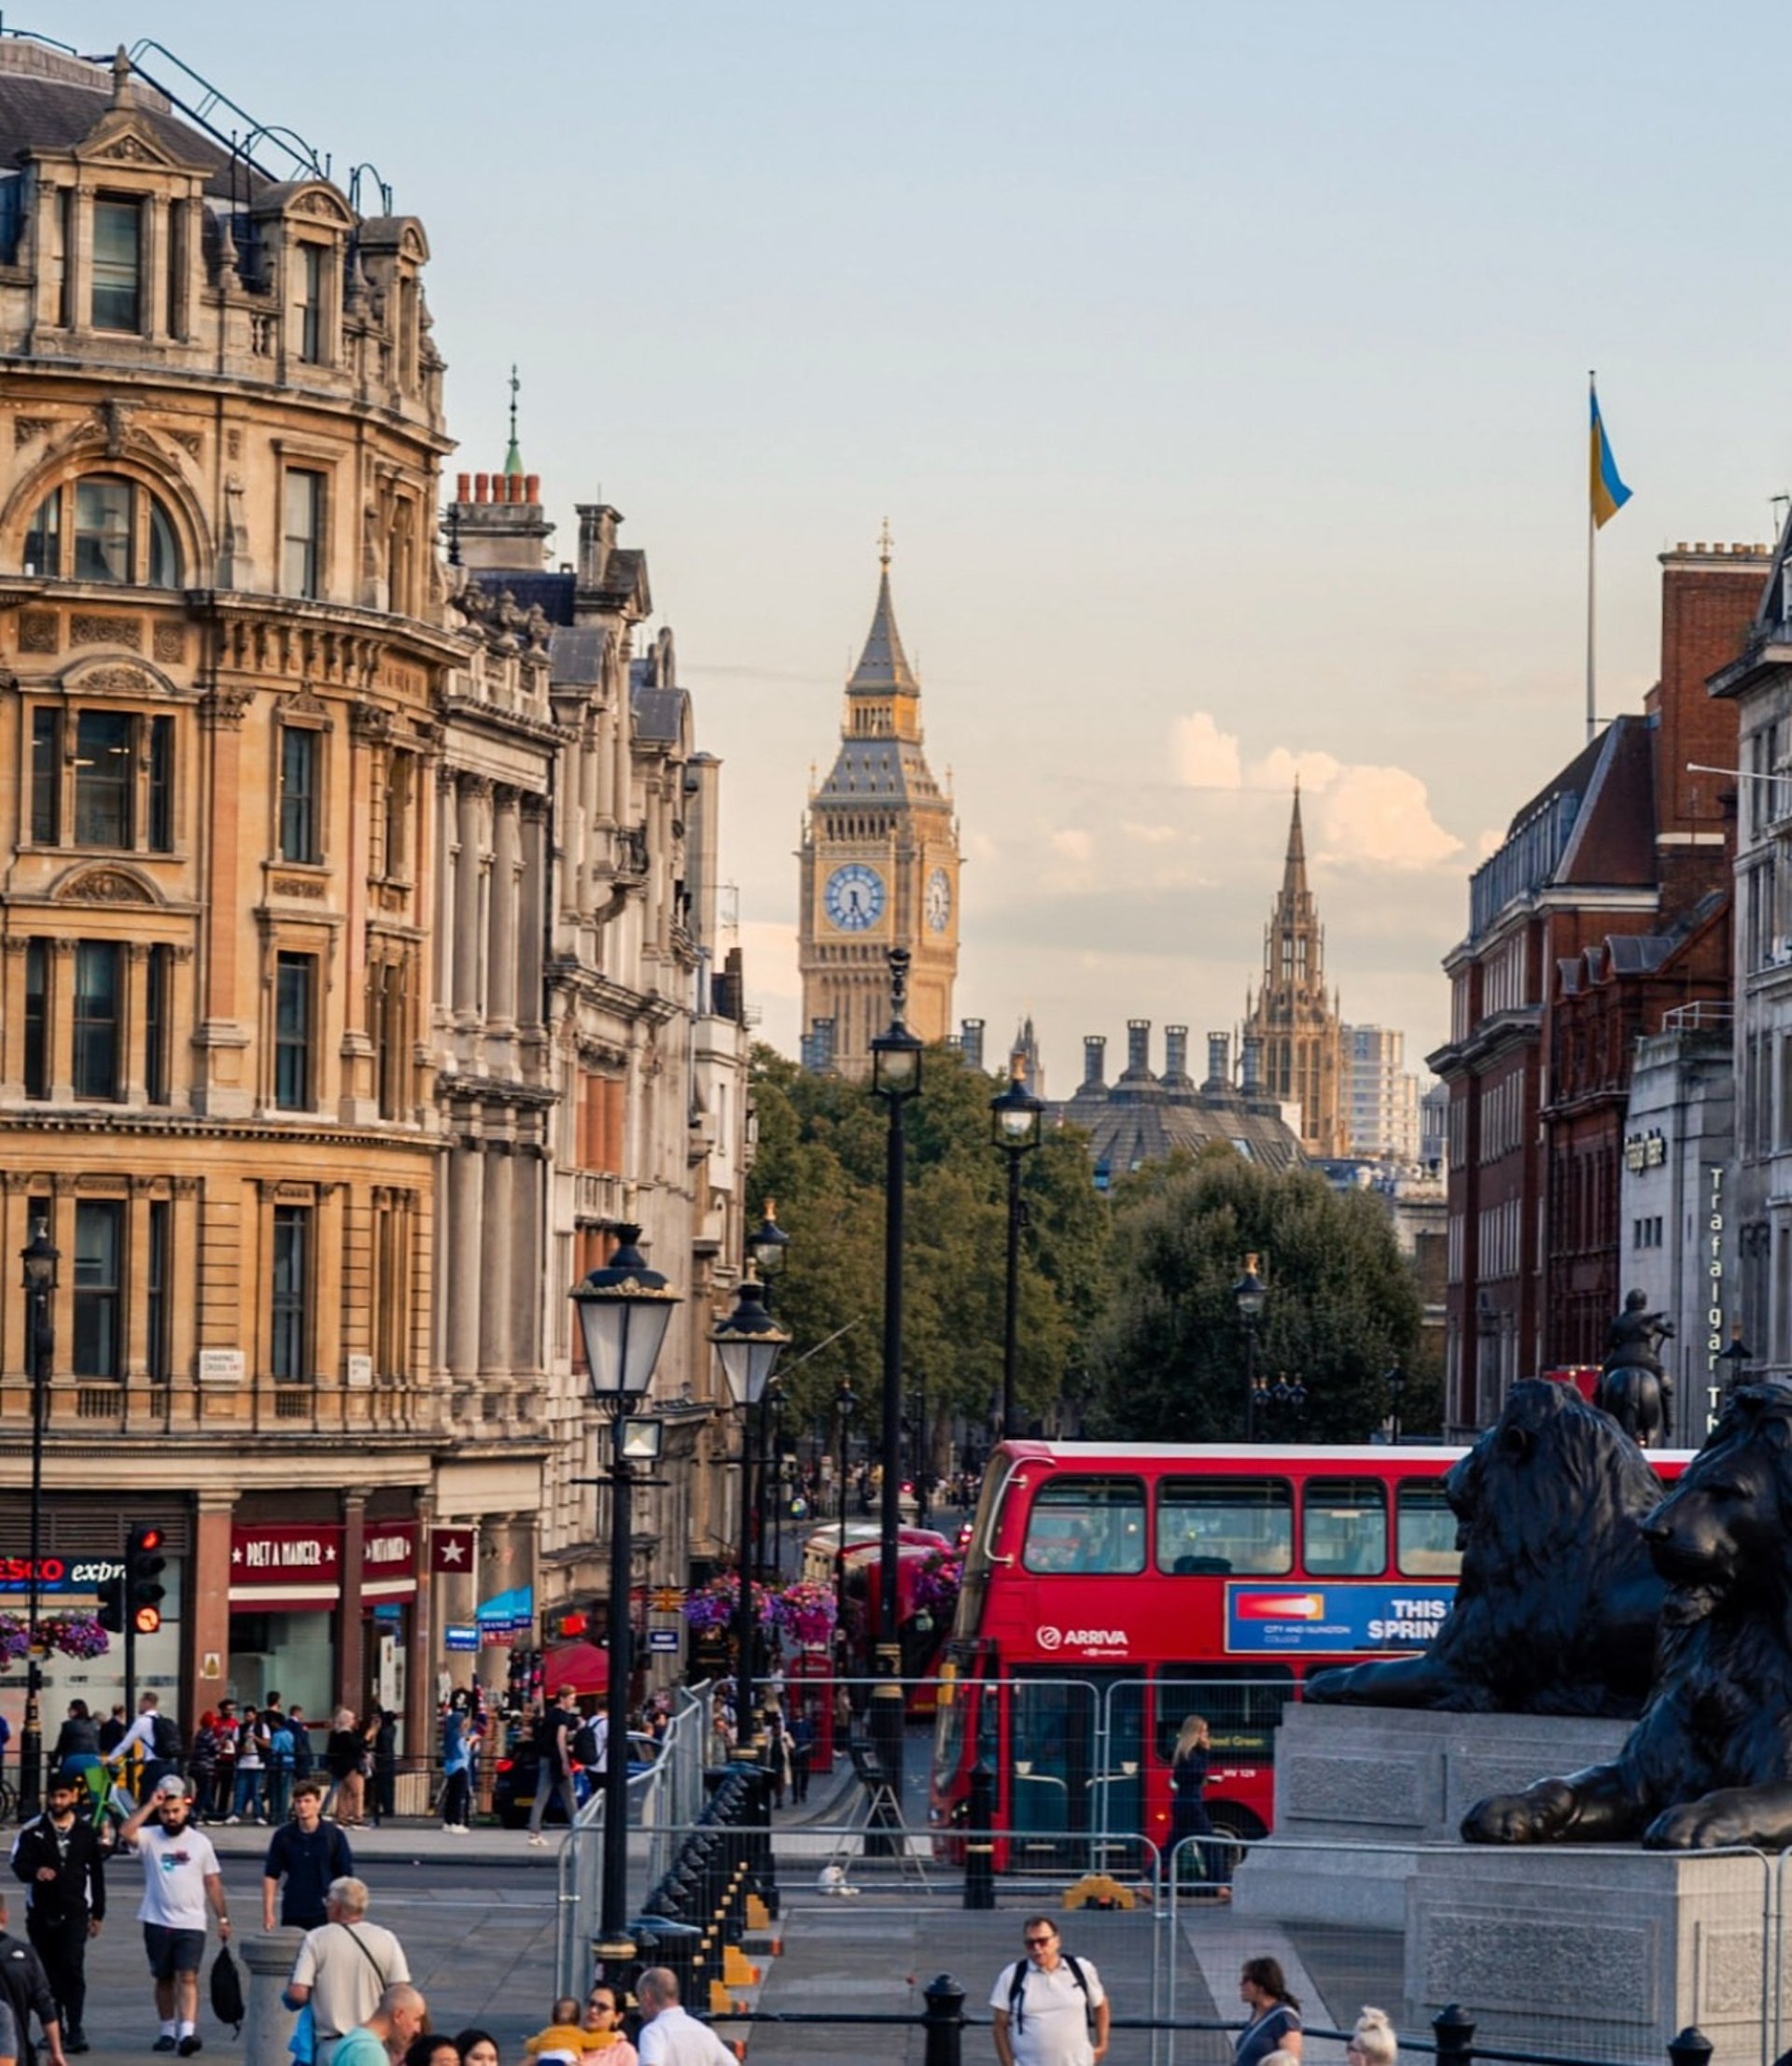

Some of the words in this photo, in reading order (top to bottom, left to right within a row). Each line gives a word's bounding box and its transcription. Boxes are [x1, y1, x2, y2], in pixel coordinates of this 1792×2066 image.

[1708, 1168, 1724, 1370] Trafalgar
[272, 1541, 280, 1567] A
[1391, 1599, 1448, 1619] THIS
[1063, 1630, 1129, 1645] ARRIVA
[1264, 1625, 1284, 1634] CITY
[1367, 1620, 1440, 1639] SPRIN
[1210, 1736, 1230, 1747] ood
[1231, 1735, 1265, 1747] Green
